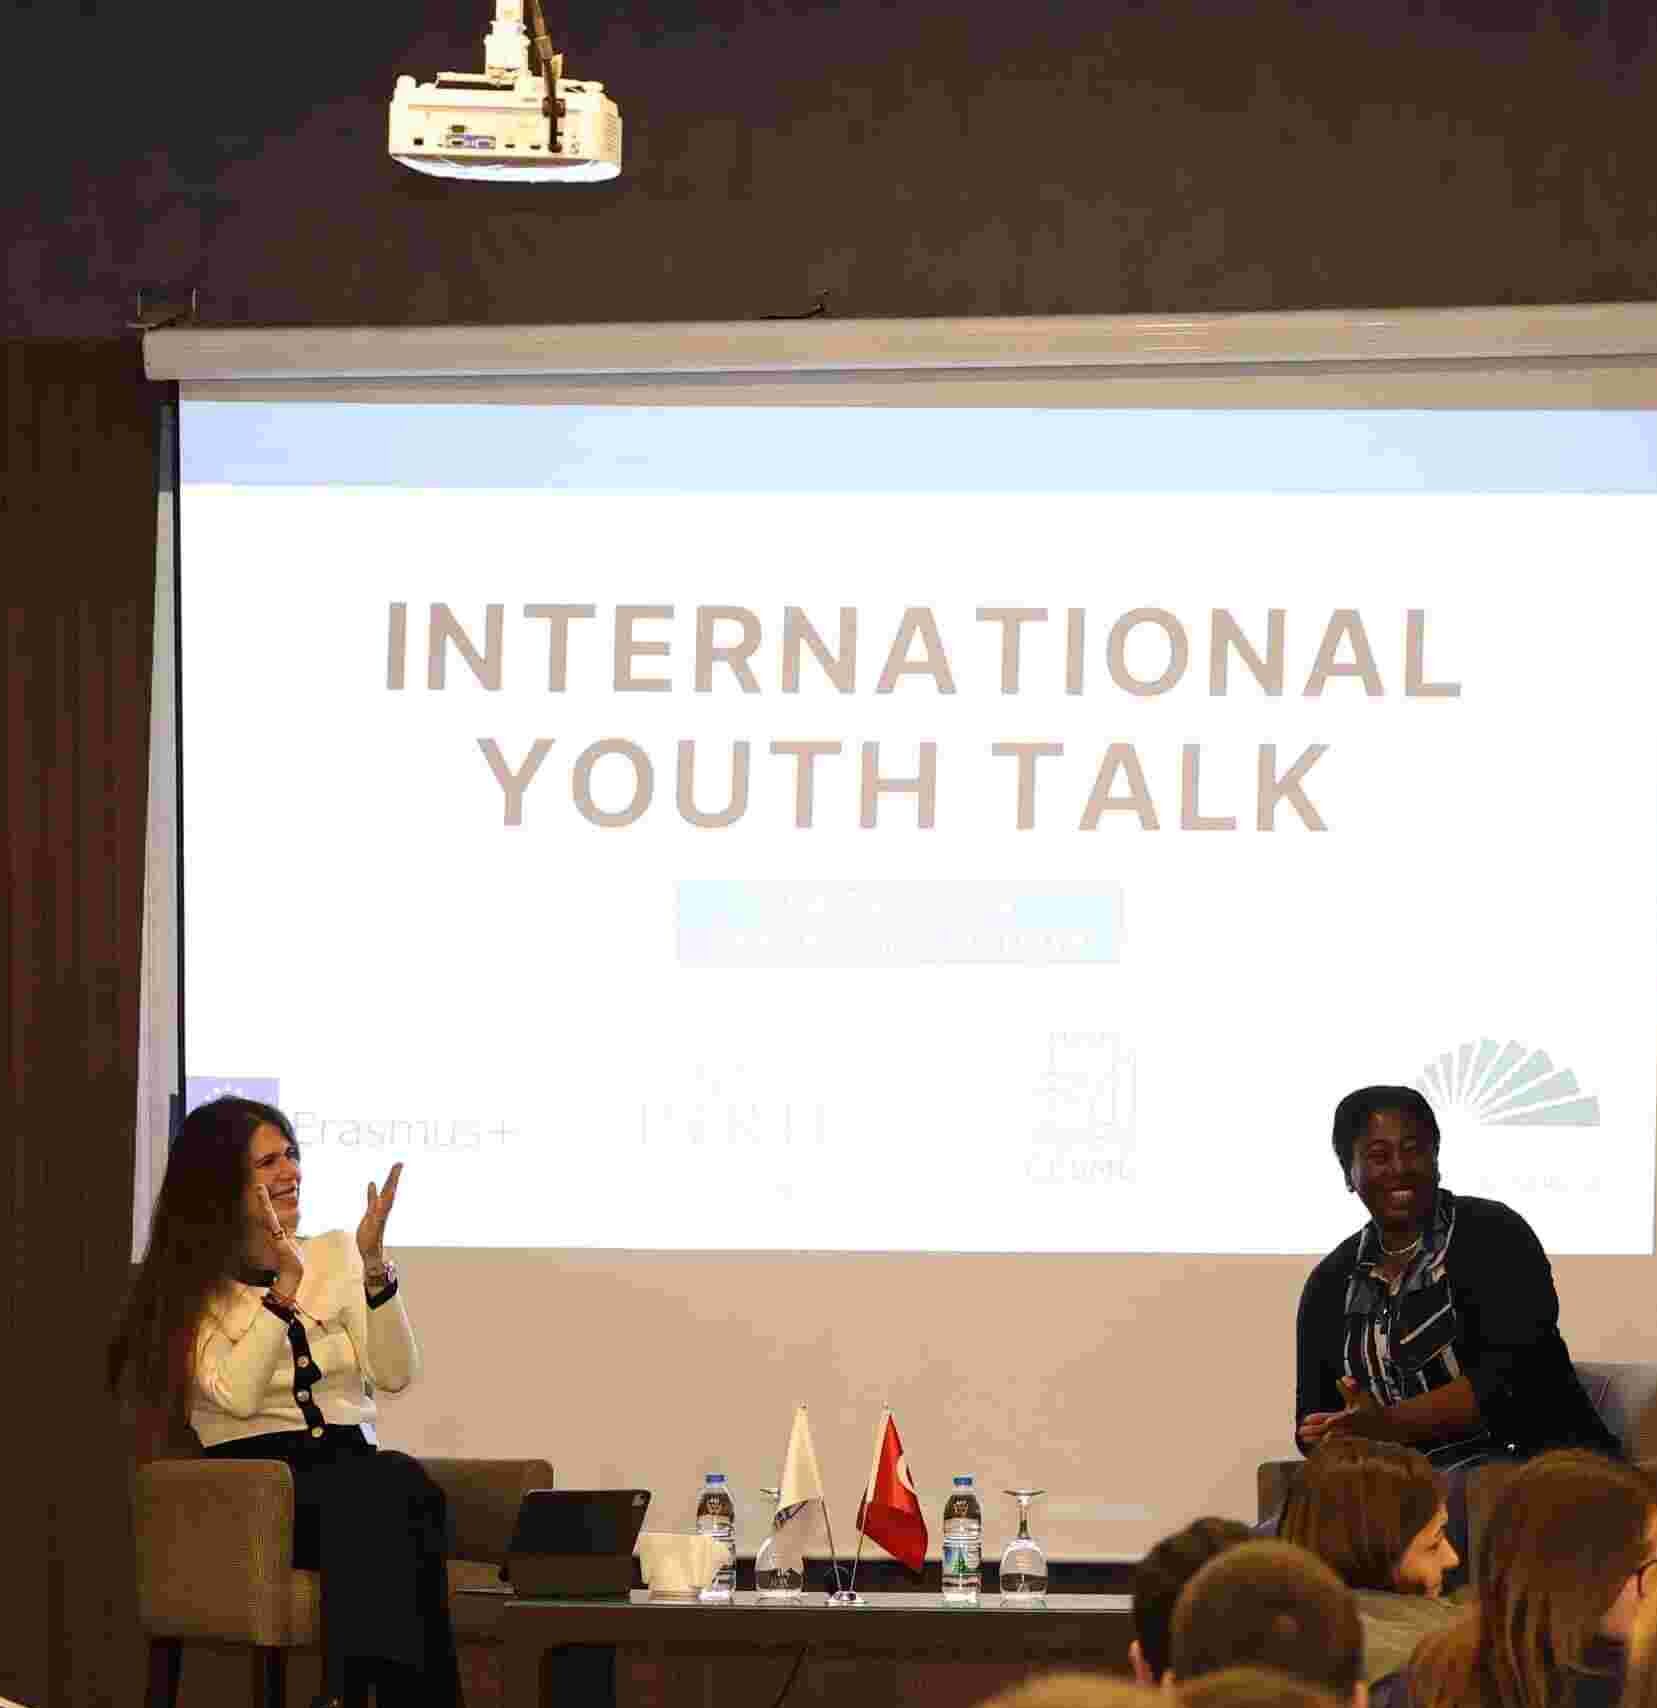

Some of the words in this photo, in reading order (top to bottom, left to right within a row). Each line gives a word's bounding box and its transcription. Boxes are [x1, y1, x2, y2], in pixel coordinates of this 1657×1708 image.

[386, 601, 1462, 699] INTERNATIONAL
[477, 737, 936, 829] YOUTH
[992, 742, 1329, 832] TALK
[294, 1111, 522, 1150] Erasmus+
